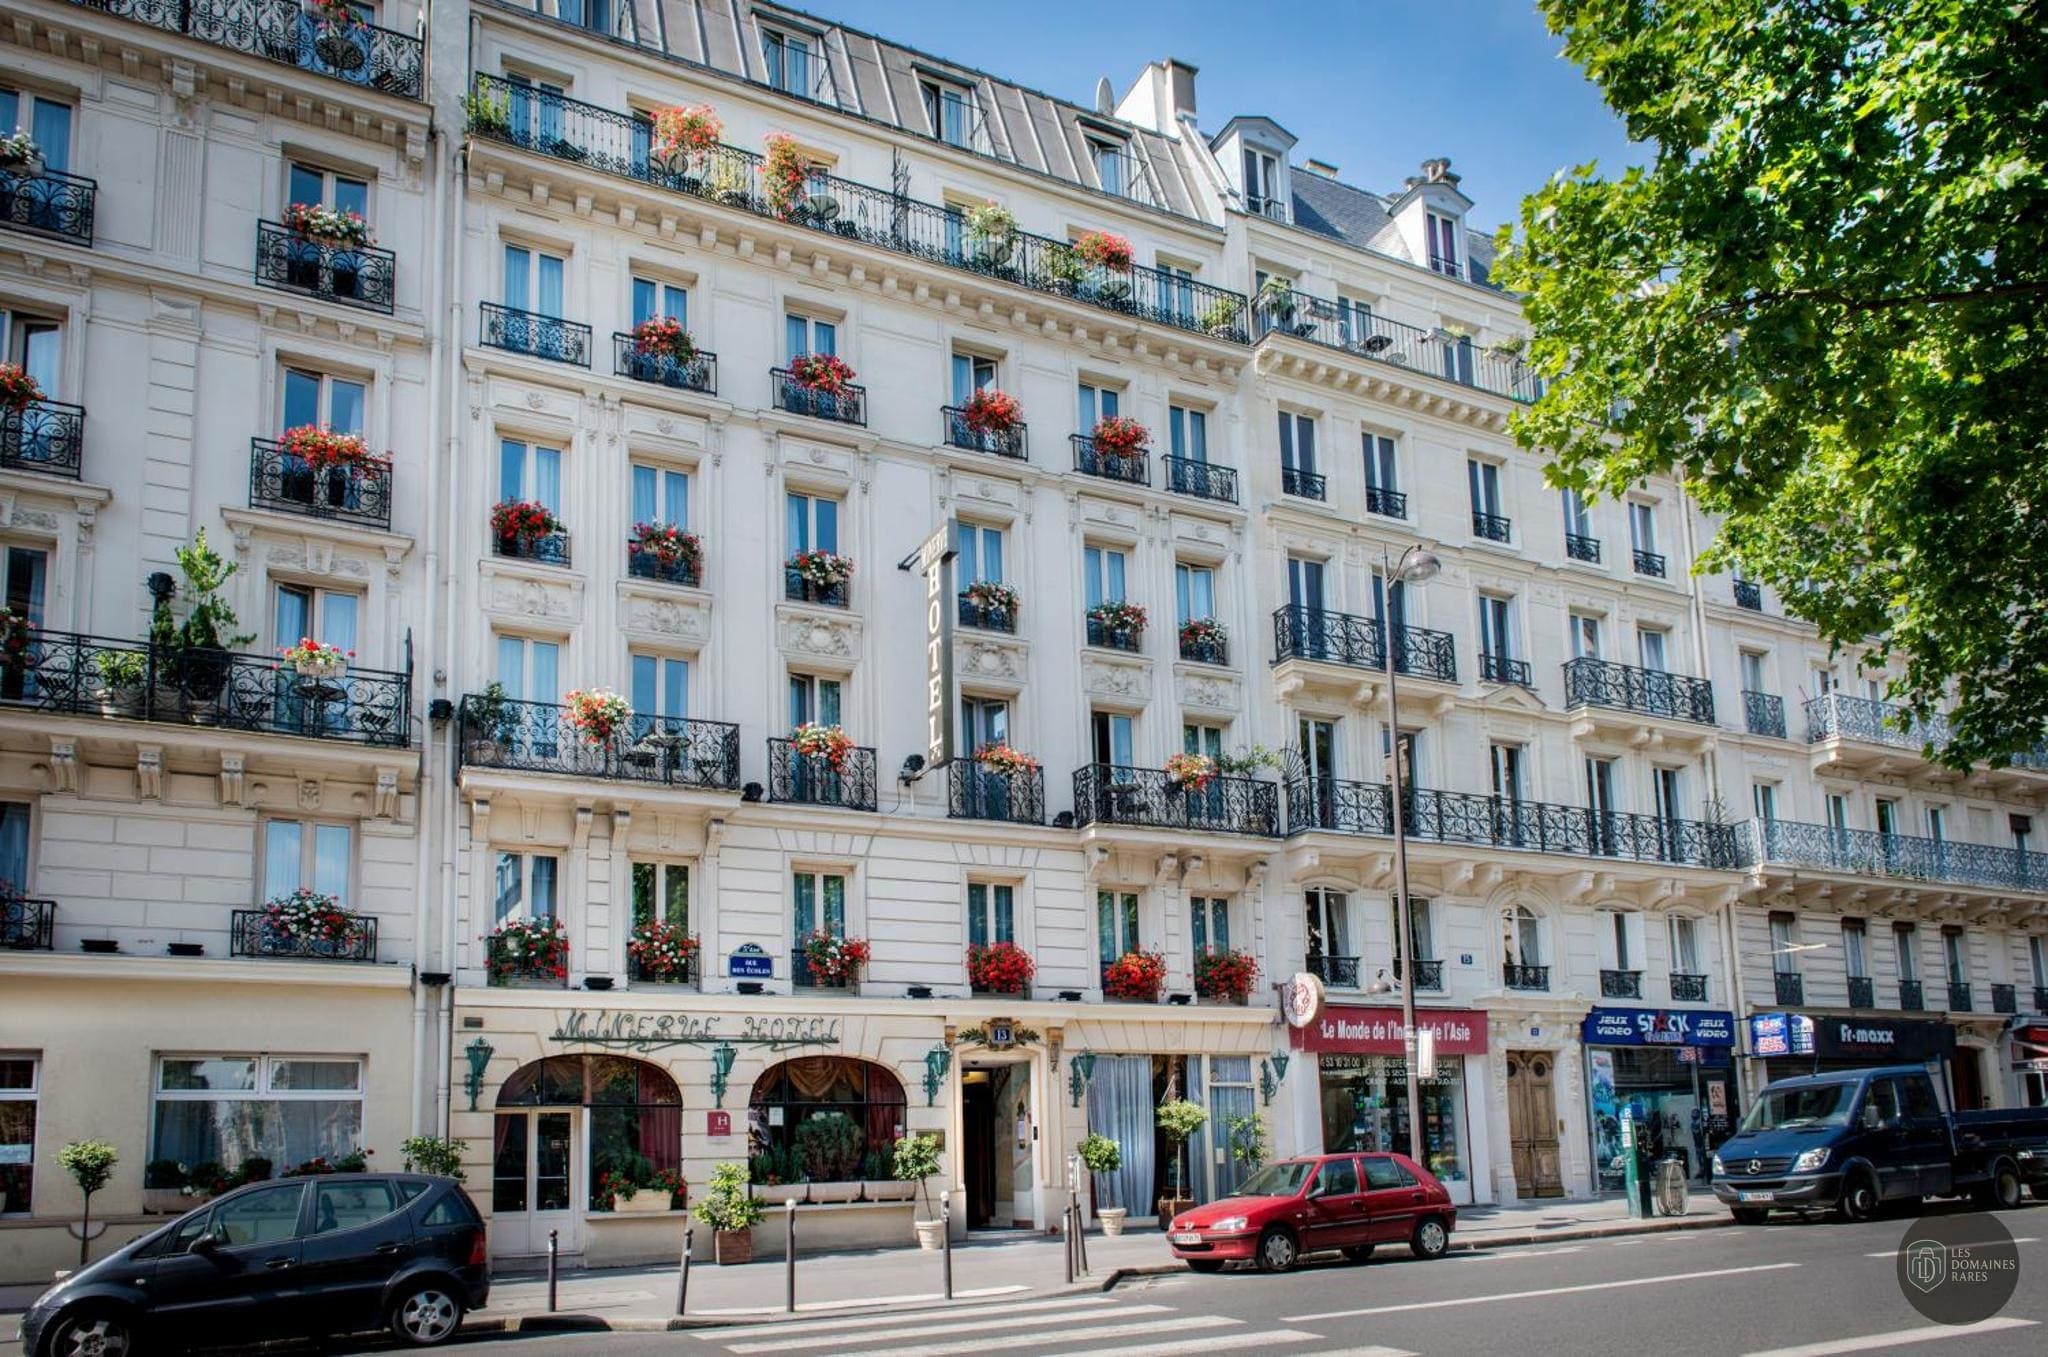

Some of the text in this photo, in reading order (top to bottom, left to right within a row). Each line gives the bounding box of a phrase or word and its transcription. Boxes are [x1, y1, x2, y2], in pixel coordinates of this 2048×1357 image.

[928, 560, 943, 749] HOTEL
[1598, 1016, 1629, 1025] JEUX
[1637, 1013, 1690, 1033] STCK
[1698, 1019, 1726, 1028] JEUX
[741, 1017, 838, 1040] HOTEL
[997, 1030, 1007, 1040] 13
[1322, 1020, 1334, 1039] Le
[1337, 1020, 1370, 1040] Monde
[1373, 1021, 1385, 1040] de
[1444, 1021, 1471, 1041] l'Asie
[717, 1116, 728, 1126] H
